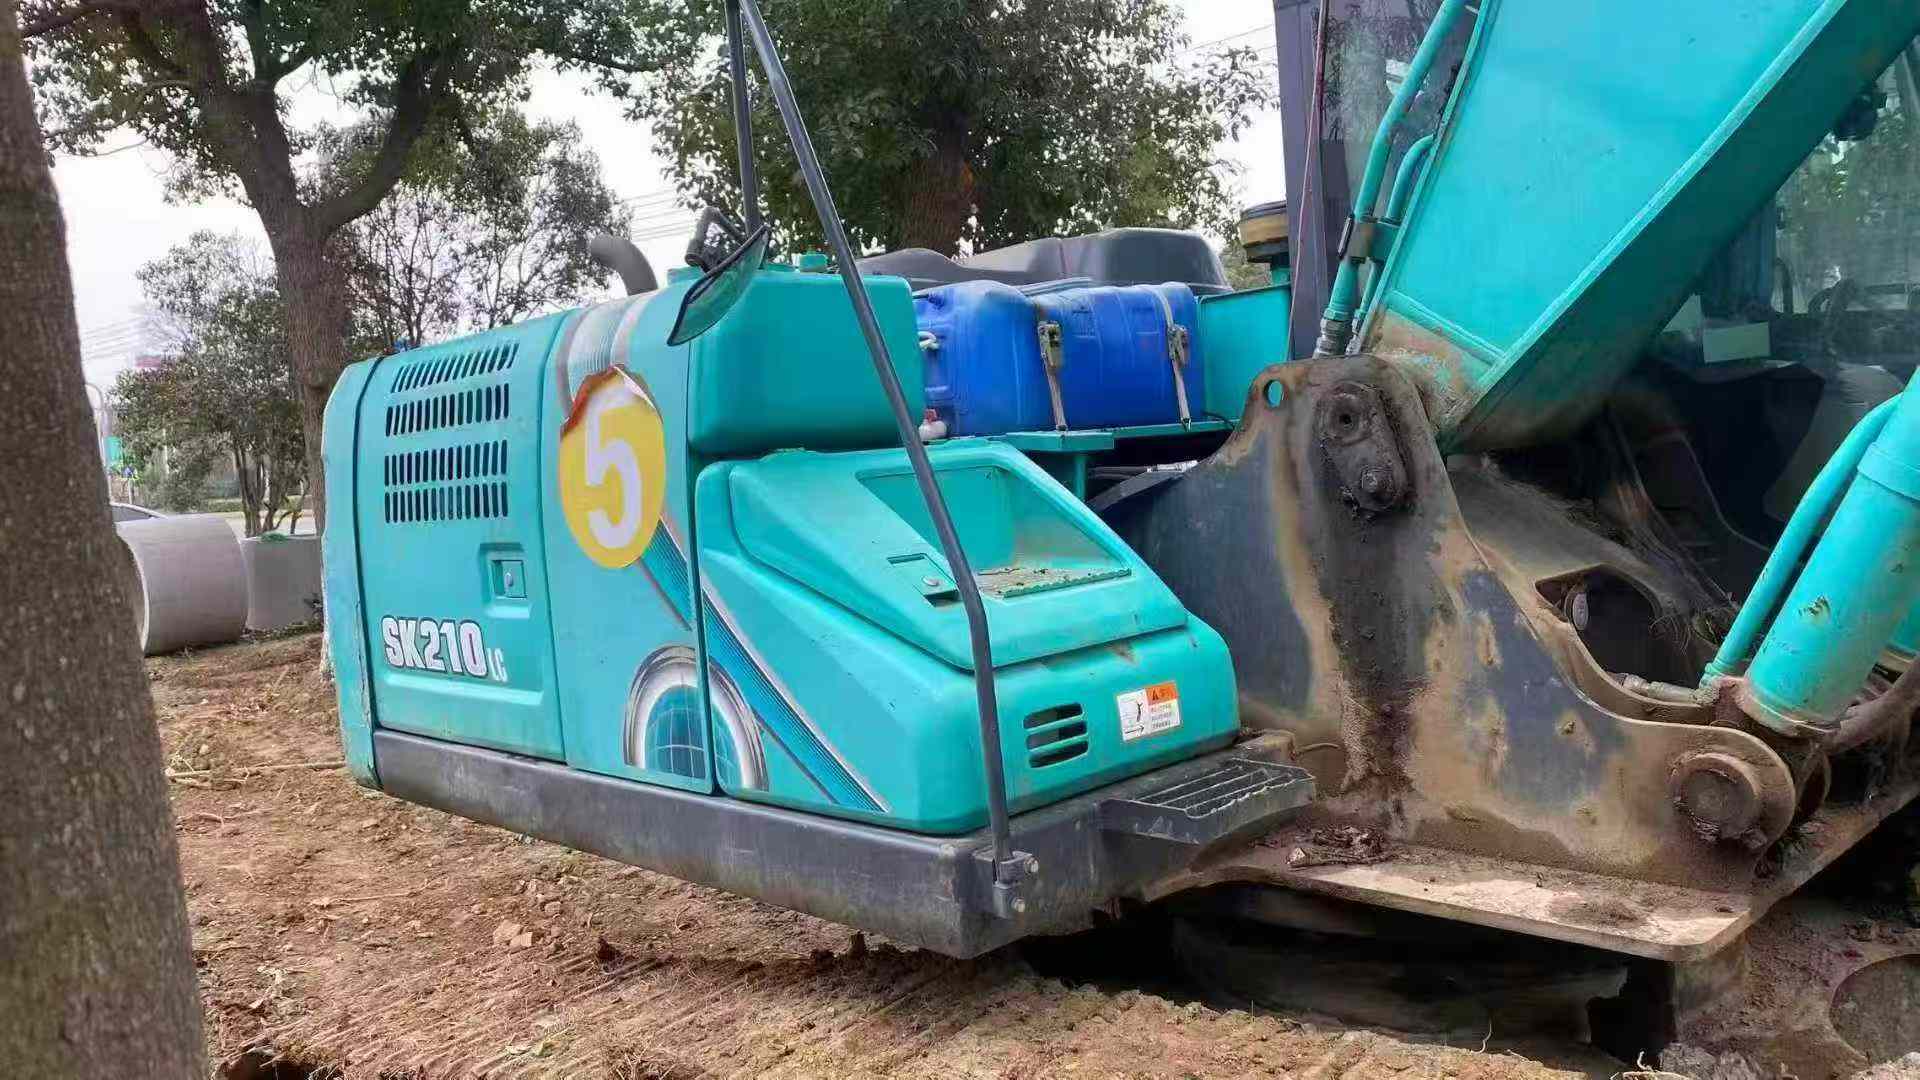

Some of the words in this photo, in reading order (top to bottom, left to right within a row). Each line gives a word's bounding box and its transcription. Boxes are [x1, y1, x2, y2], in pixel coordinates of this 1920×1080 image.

[585, 382, 643, 549] 5
[381, 615, 489, 678] SK210
[486, 648, 508, 683] LC
